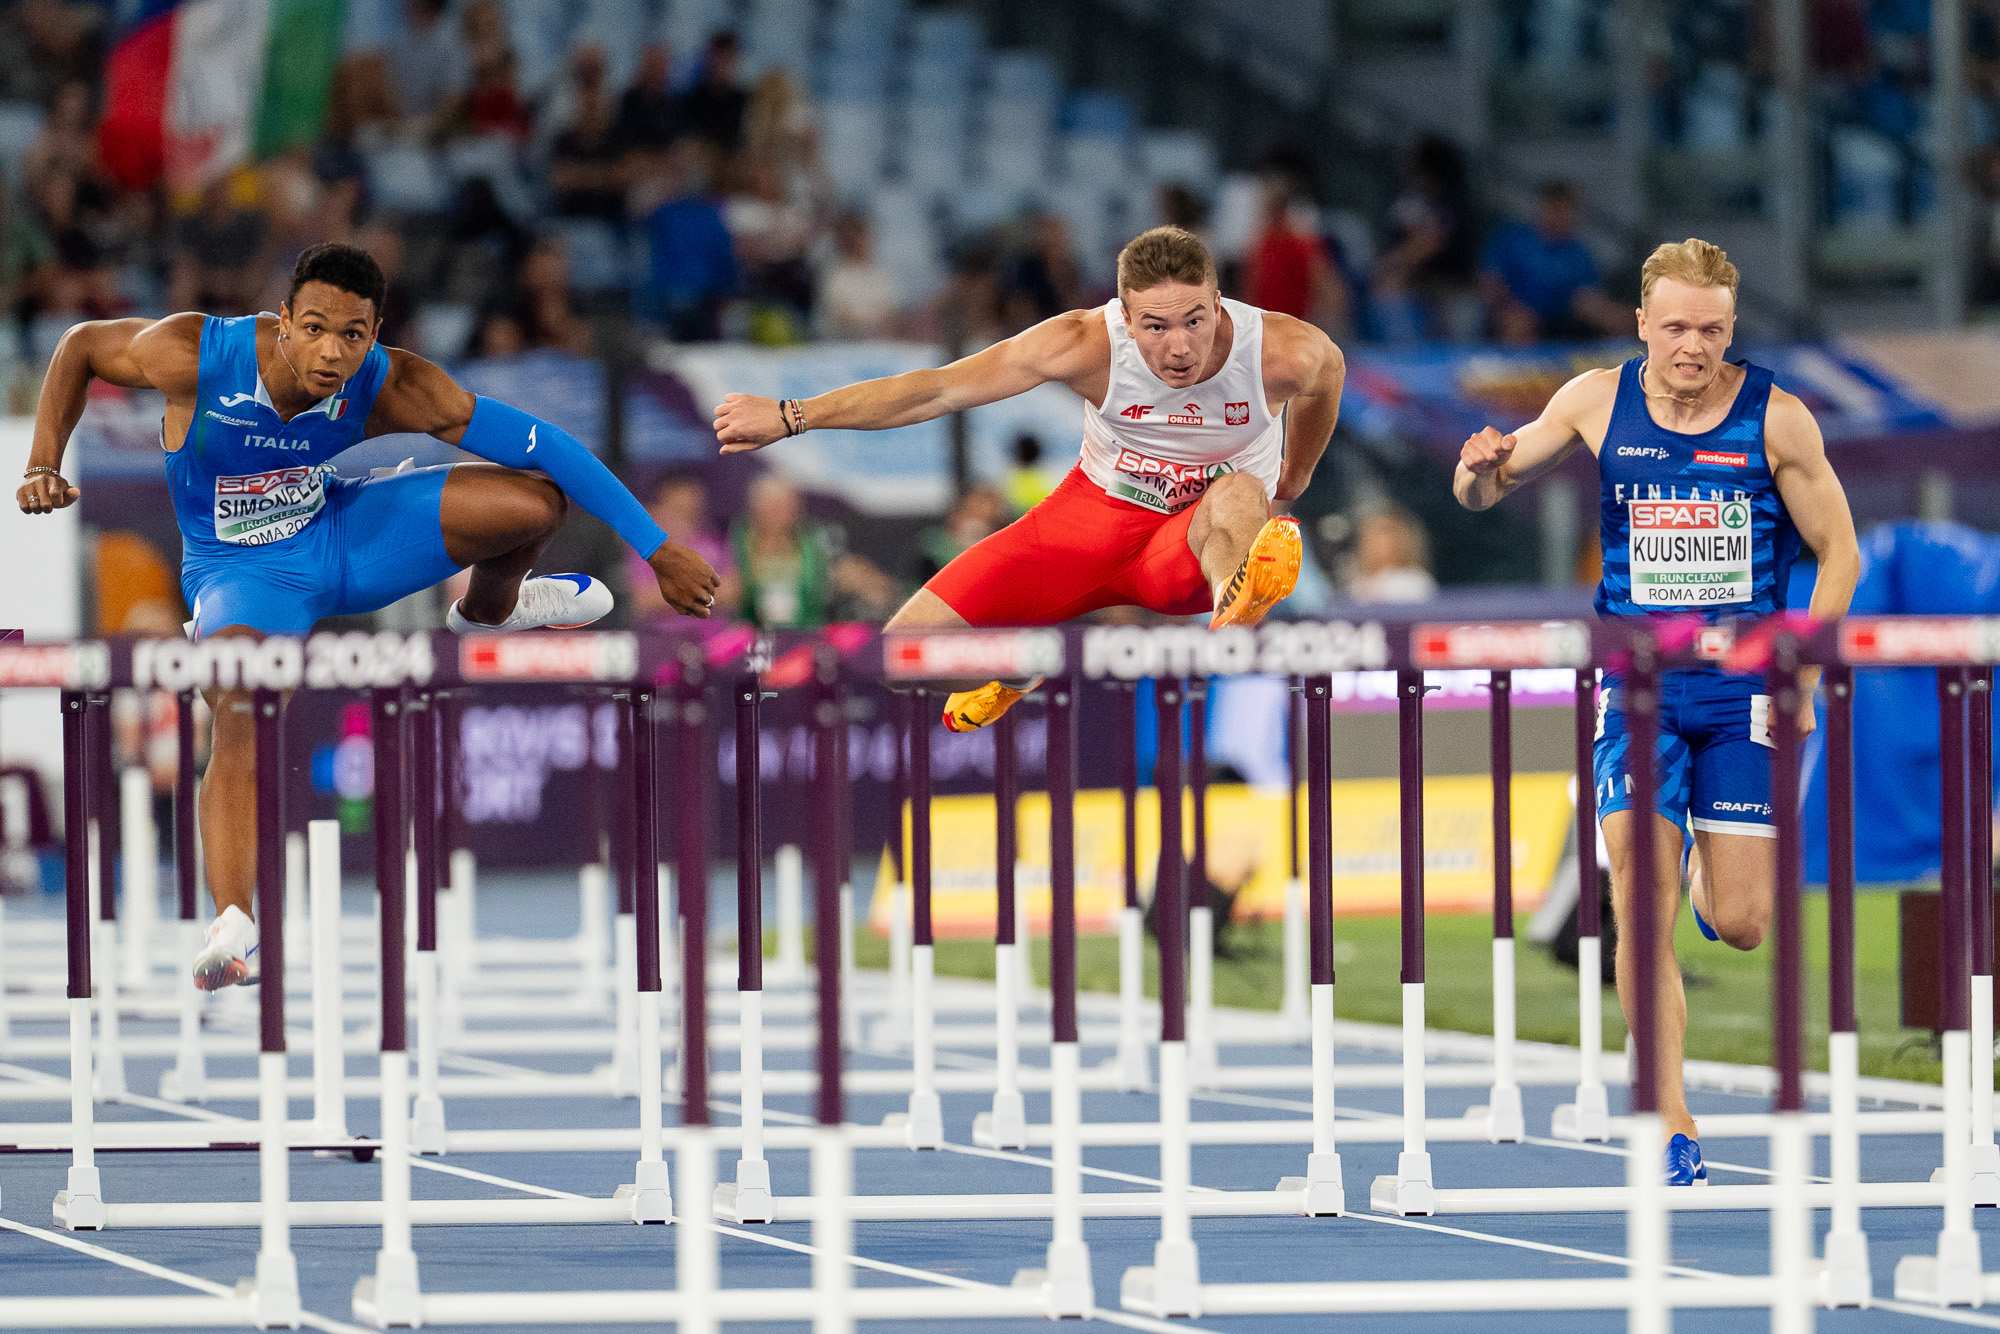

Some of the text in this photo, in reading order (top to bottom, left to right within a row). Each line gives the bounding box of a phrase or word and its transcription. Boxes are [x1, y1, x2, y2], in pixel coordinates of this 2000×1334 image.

[1120, 404, 1155, 419] 4F
[1169, 415, 1201, 425] ORLEN
[244, 434, 310, 451] ITALIA
[1617, 446, 1658, 458] CRAFT
[1696, 452, 1746, 466] motonet
[1118, 451, 1201, 483] SPAR
[220, 471, 307, 493] SPAR
[1134, 490, 1140, 499] I
[1140, 492, 1164, 508] RUN
[241, 507, 309, 532] I RUN CLEAN
[1634, 506, 1717, 526] SPAR
[1633, 535, 1747, 562] KUUSINIEMI
[1660, 573, 1684, 583] RUN
[1648, 586, 1736, 601] ROMA 2024
[1712, 801, 1763, 813] CRAFT
